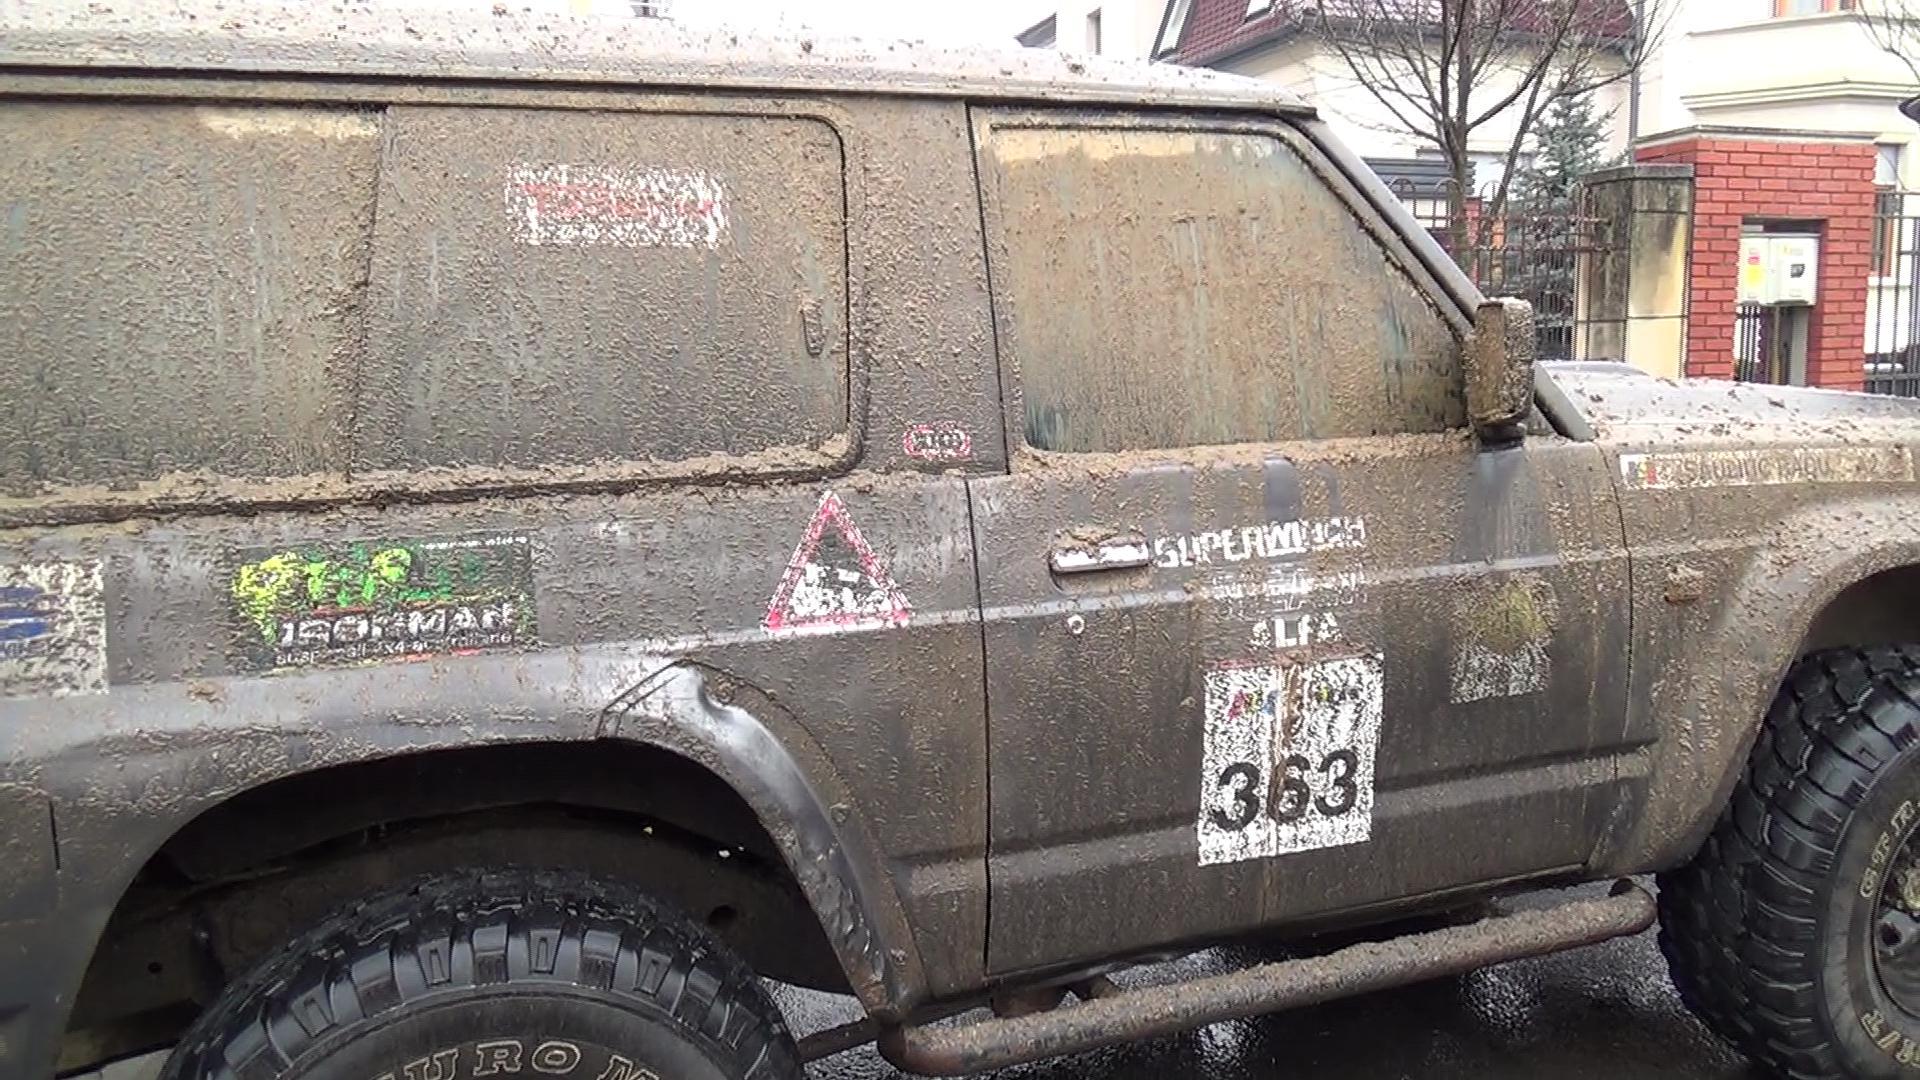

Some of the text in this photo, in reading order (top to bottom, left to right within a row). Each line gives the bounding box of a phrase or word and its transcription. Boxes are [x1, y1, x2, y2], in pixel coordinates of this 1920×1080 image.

[1153, 516, 1366, 568] SUPERWINCH
[1209, 749, 1358, 832] 363
[374, 1039, 582, 1080] URO
